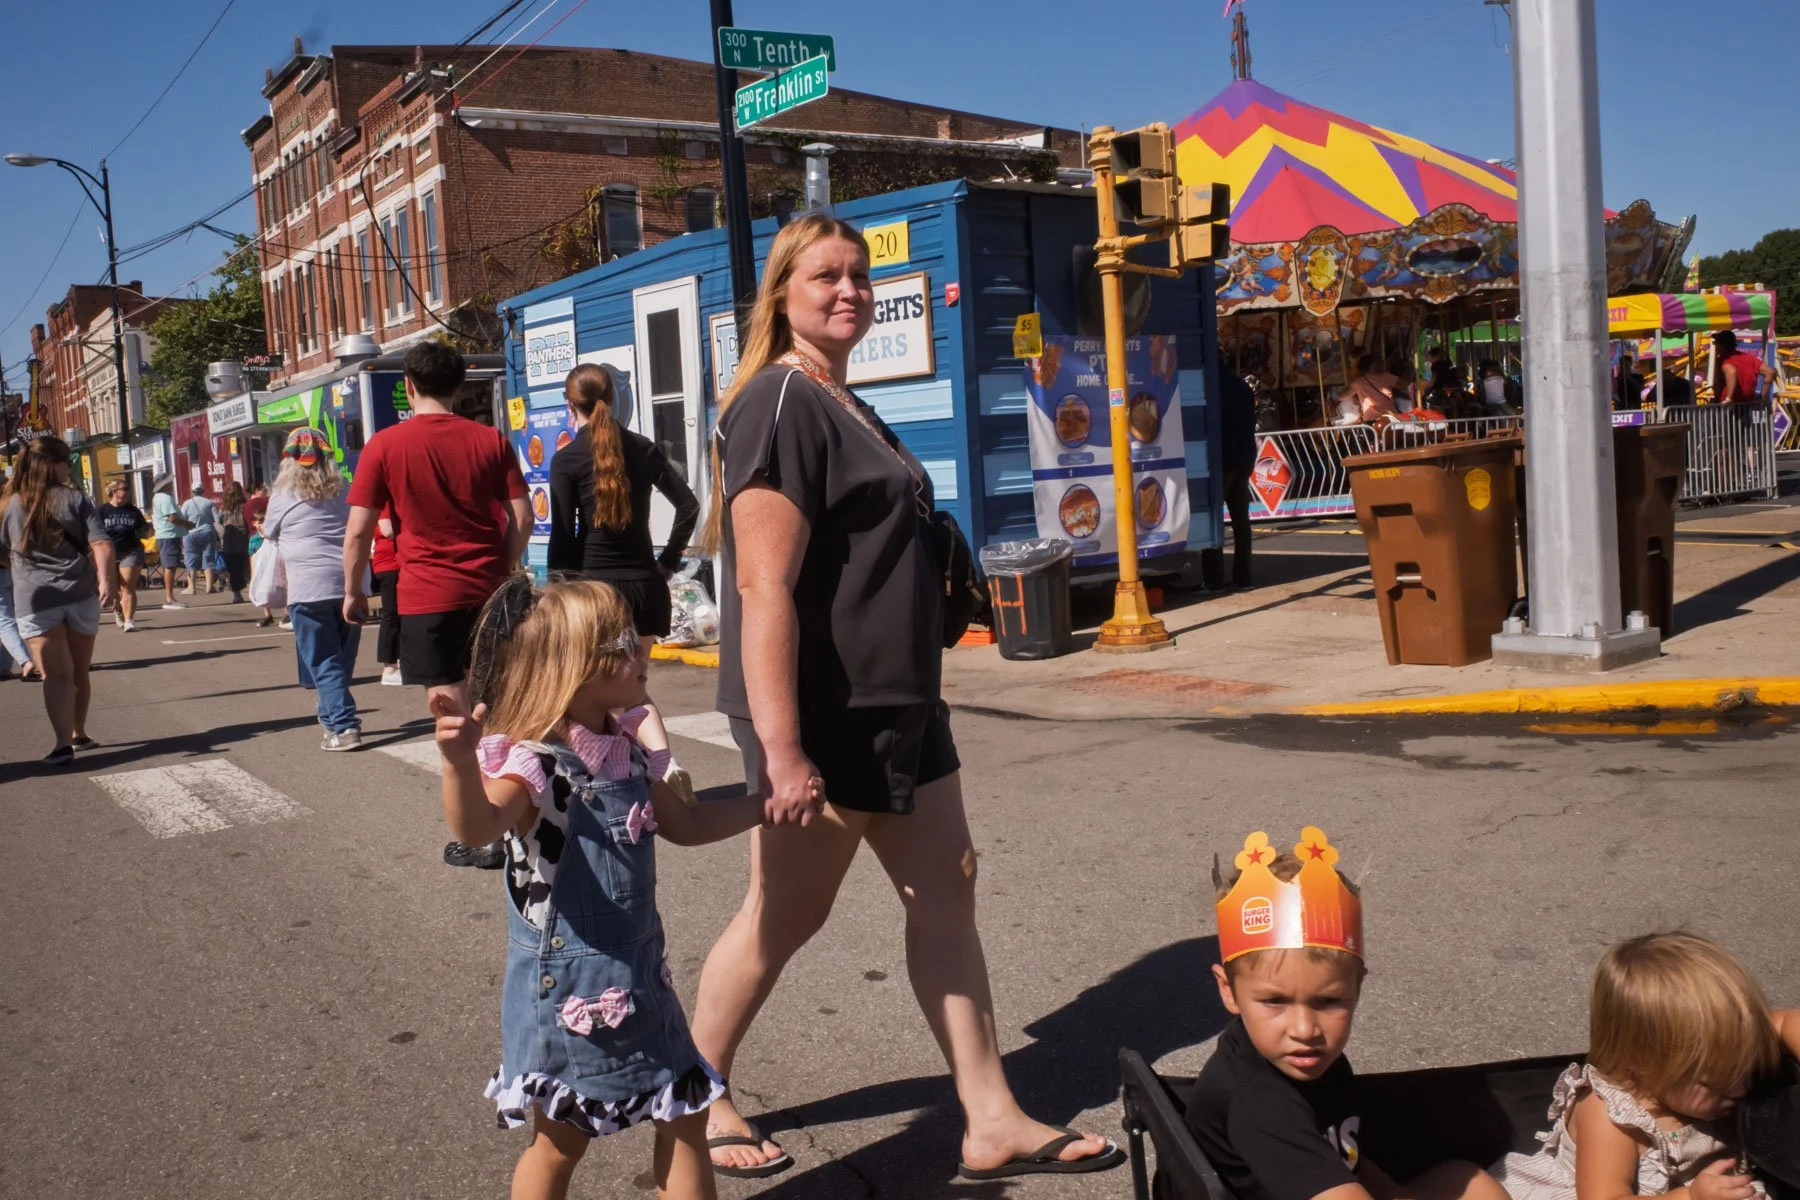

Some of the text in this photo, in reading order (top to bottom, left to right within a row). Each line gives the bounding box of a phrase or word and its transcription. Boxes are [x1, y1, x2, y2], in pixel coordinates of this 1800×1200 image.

[725, 32, 747, 47] 300
[753, 36, 810, 63] Tenth
[733, 50, 741, 63] N
[738, 70, 824, 114] 2100 Franklin St
[744, 107, 750, 120] W
[874, 231, 897, 259] 20
[874, 293, 924, 315] GHTS
[1074, 340, 1102, 353] PERRY
[526, 342, 574, 367] PANTHERS
[1076, 374, 1101, 388] HOME
[17, 426, 33, 437] SIX
[22, 429, 53, 440] STRINGS
[1243, 907, 1271, 917] BURGER
[1244, 915, 1271, 927] KING
